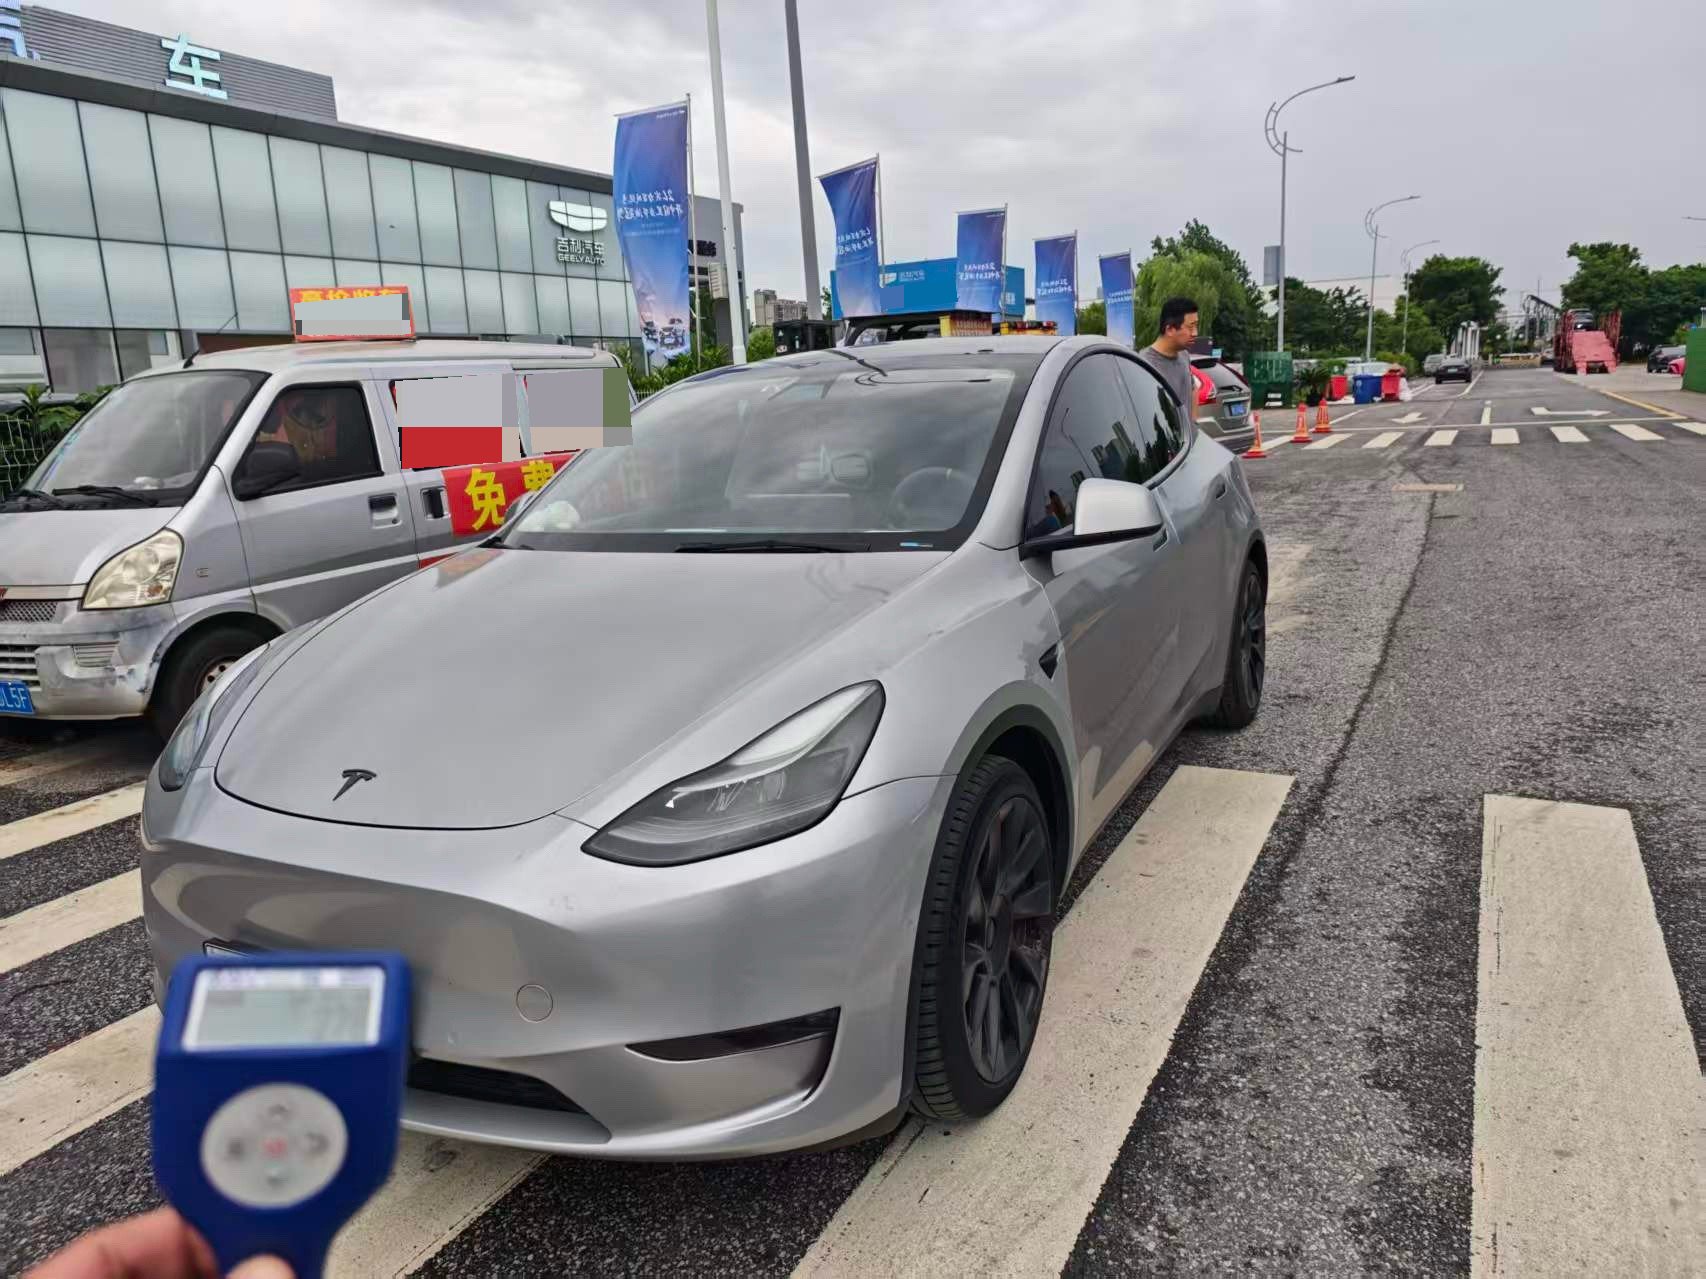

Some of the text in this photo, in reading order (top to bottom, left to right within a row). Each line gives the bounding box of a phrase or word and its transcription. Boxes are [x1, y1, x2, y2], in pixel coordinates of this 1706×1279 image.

[557, 237, 605, 256] 吉利汽车
[558, 253, 584, 263] GEELY
